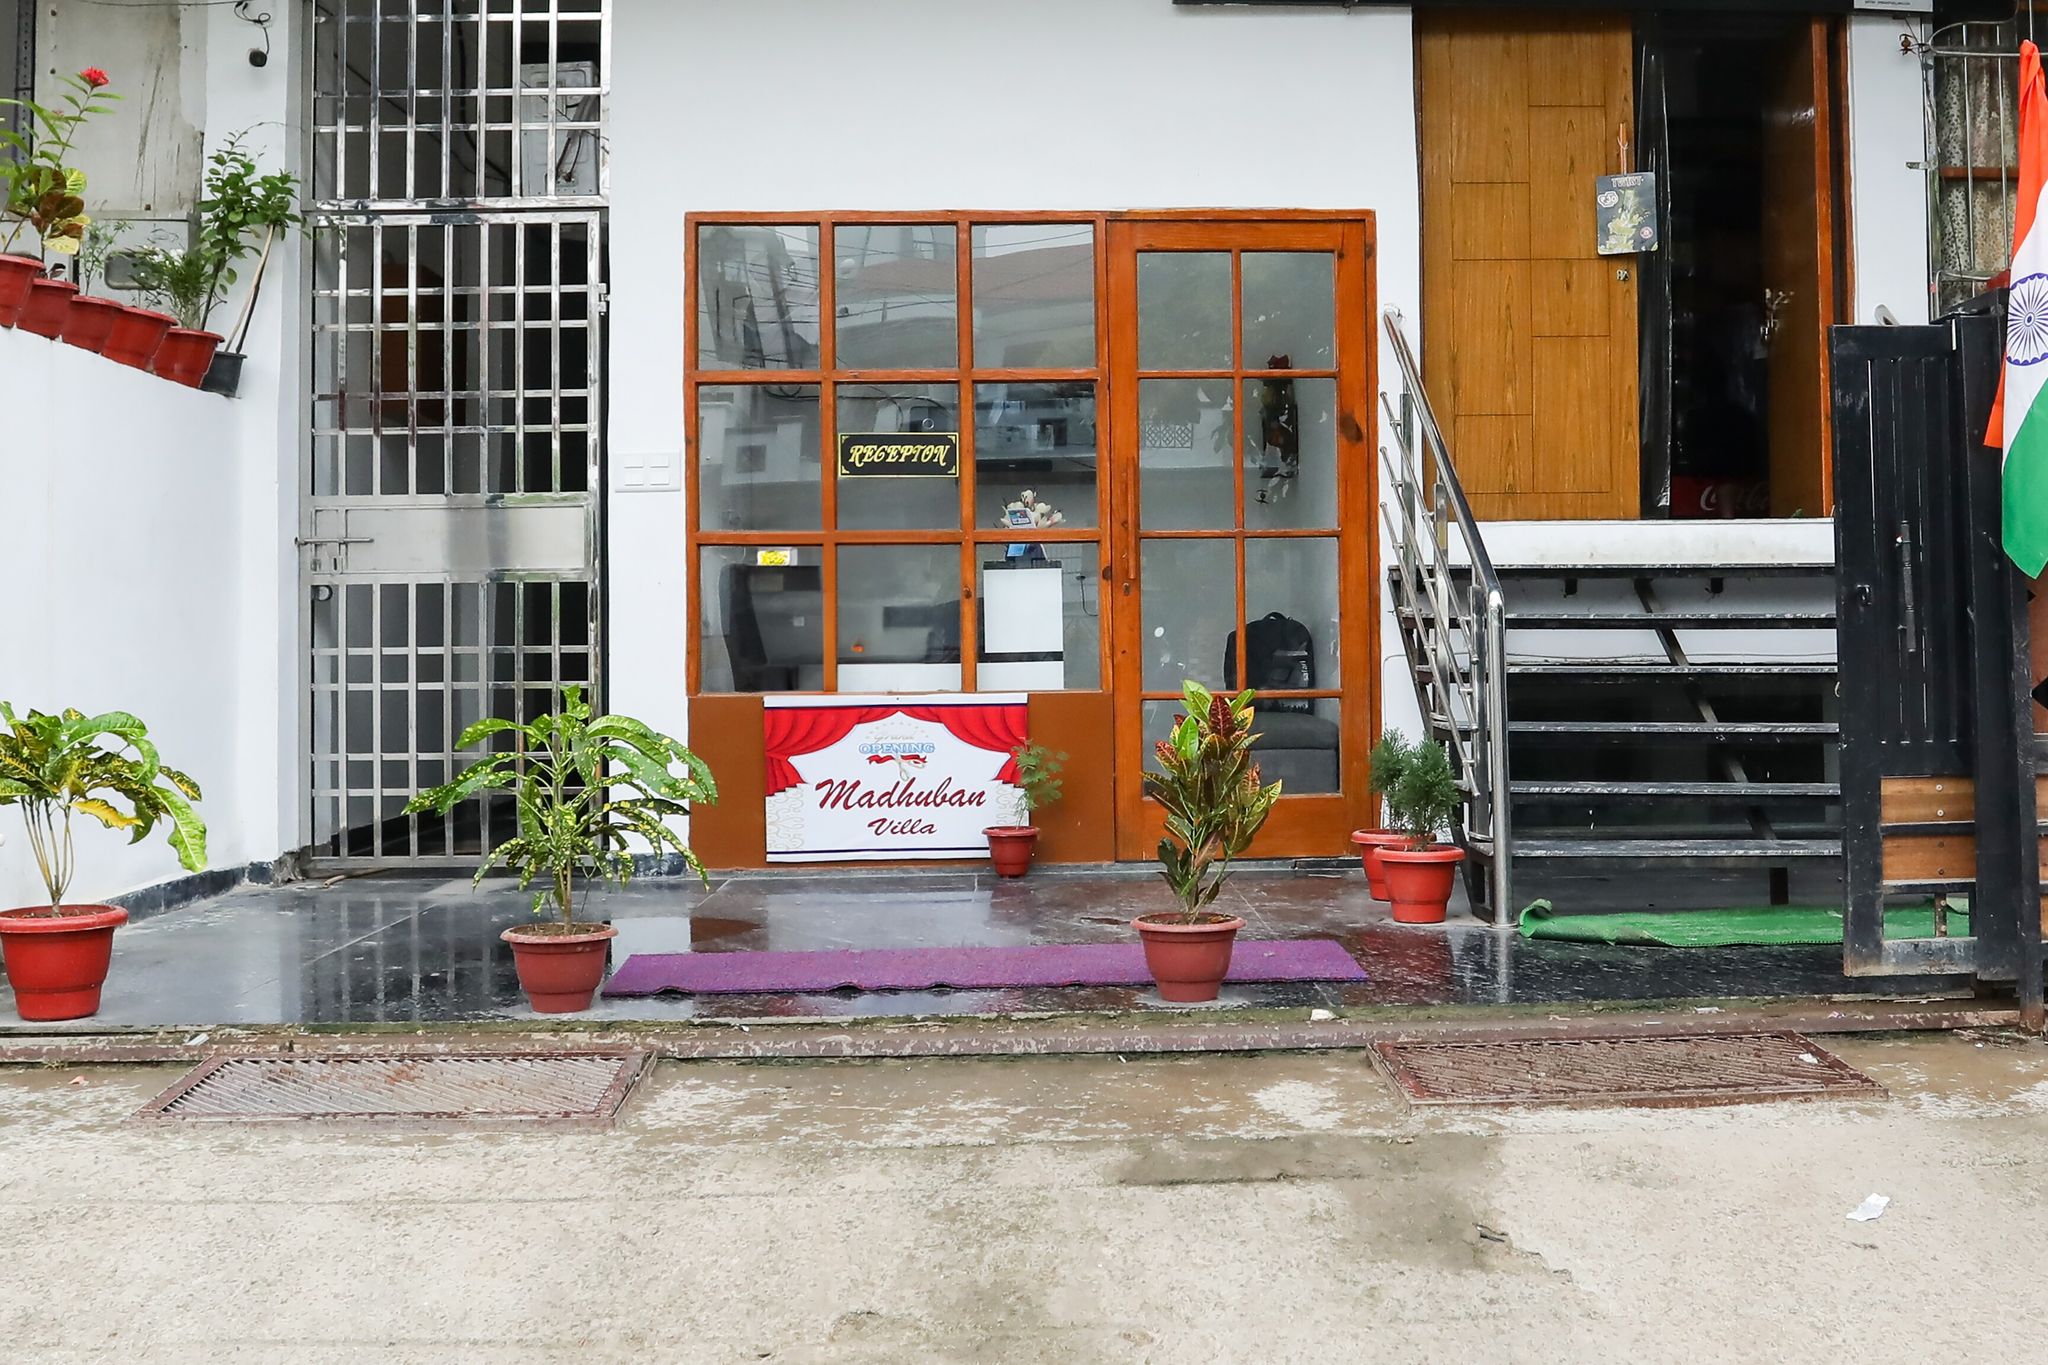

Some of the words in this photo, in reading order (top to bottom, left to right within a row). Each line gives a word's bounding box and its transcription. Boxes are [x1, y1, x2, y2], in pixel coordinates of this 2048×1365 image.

[858, 742, 935, 754] OPENING
[815, 777, 986, 810] Madhuban
[867, 817, 937, 836] Villa
